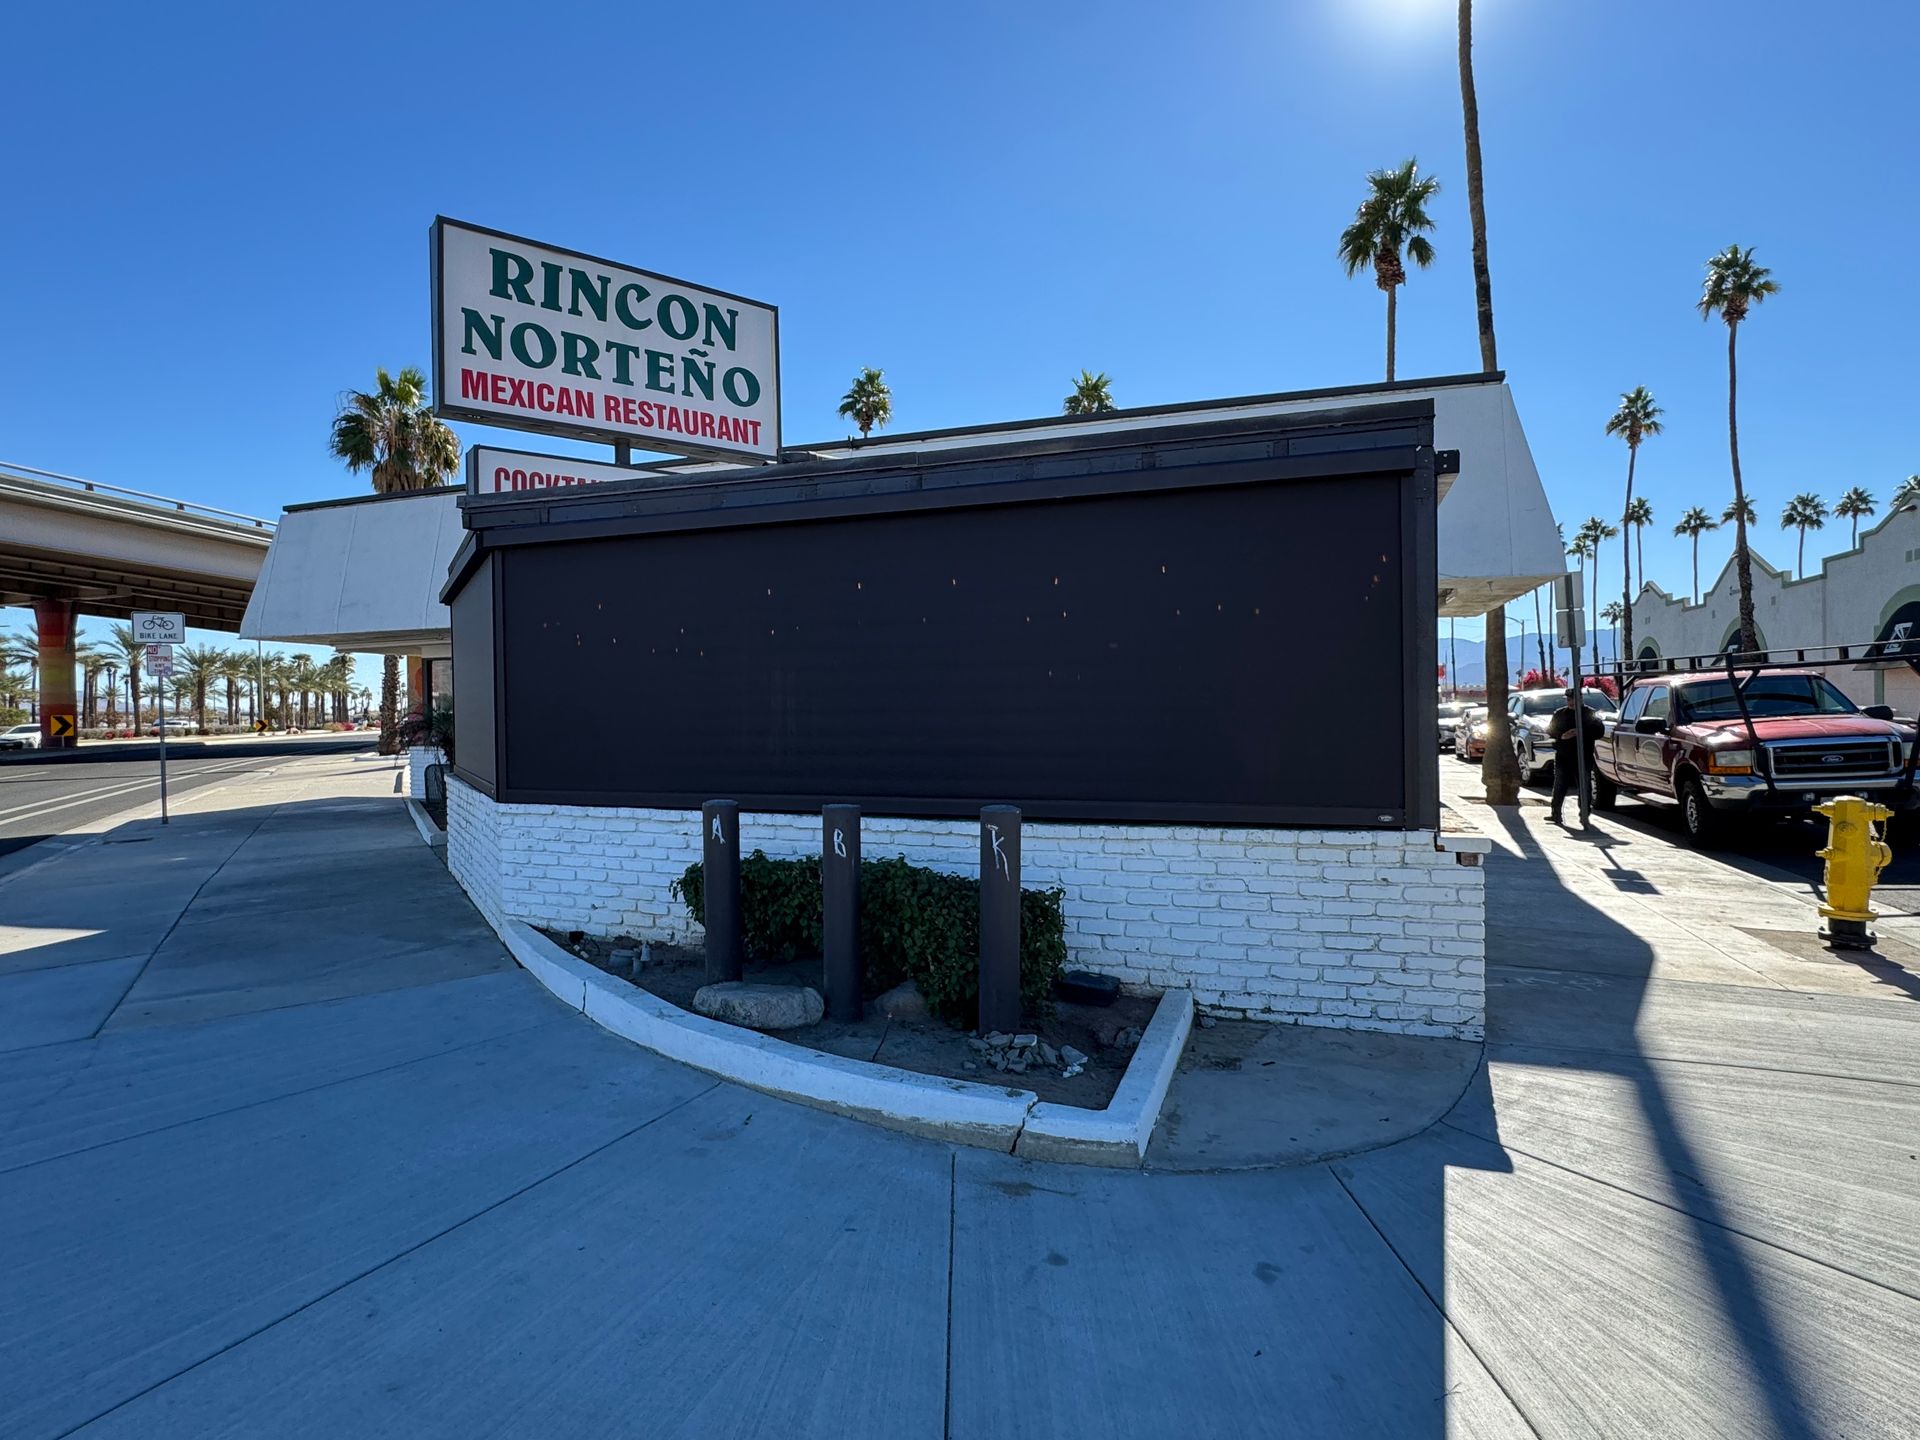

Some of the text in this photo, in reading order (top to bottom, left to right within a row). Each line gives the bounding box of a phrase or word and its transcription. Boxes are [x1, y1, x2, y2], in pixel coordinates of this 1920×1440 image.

[489, 247, 739, 352] RINCON
[461, 307, 761, 408] NORTEÑO
[461, 368, 762, 446] MEXICAN RESTAURANT
[494, 466, 598, 492] COCK
[147, 646, 157, 654] NO
